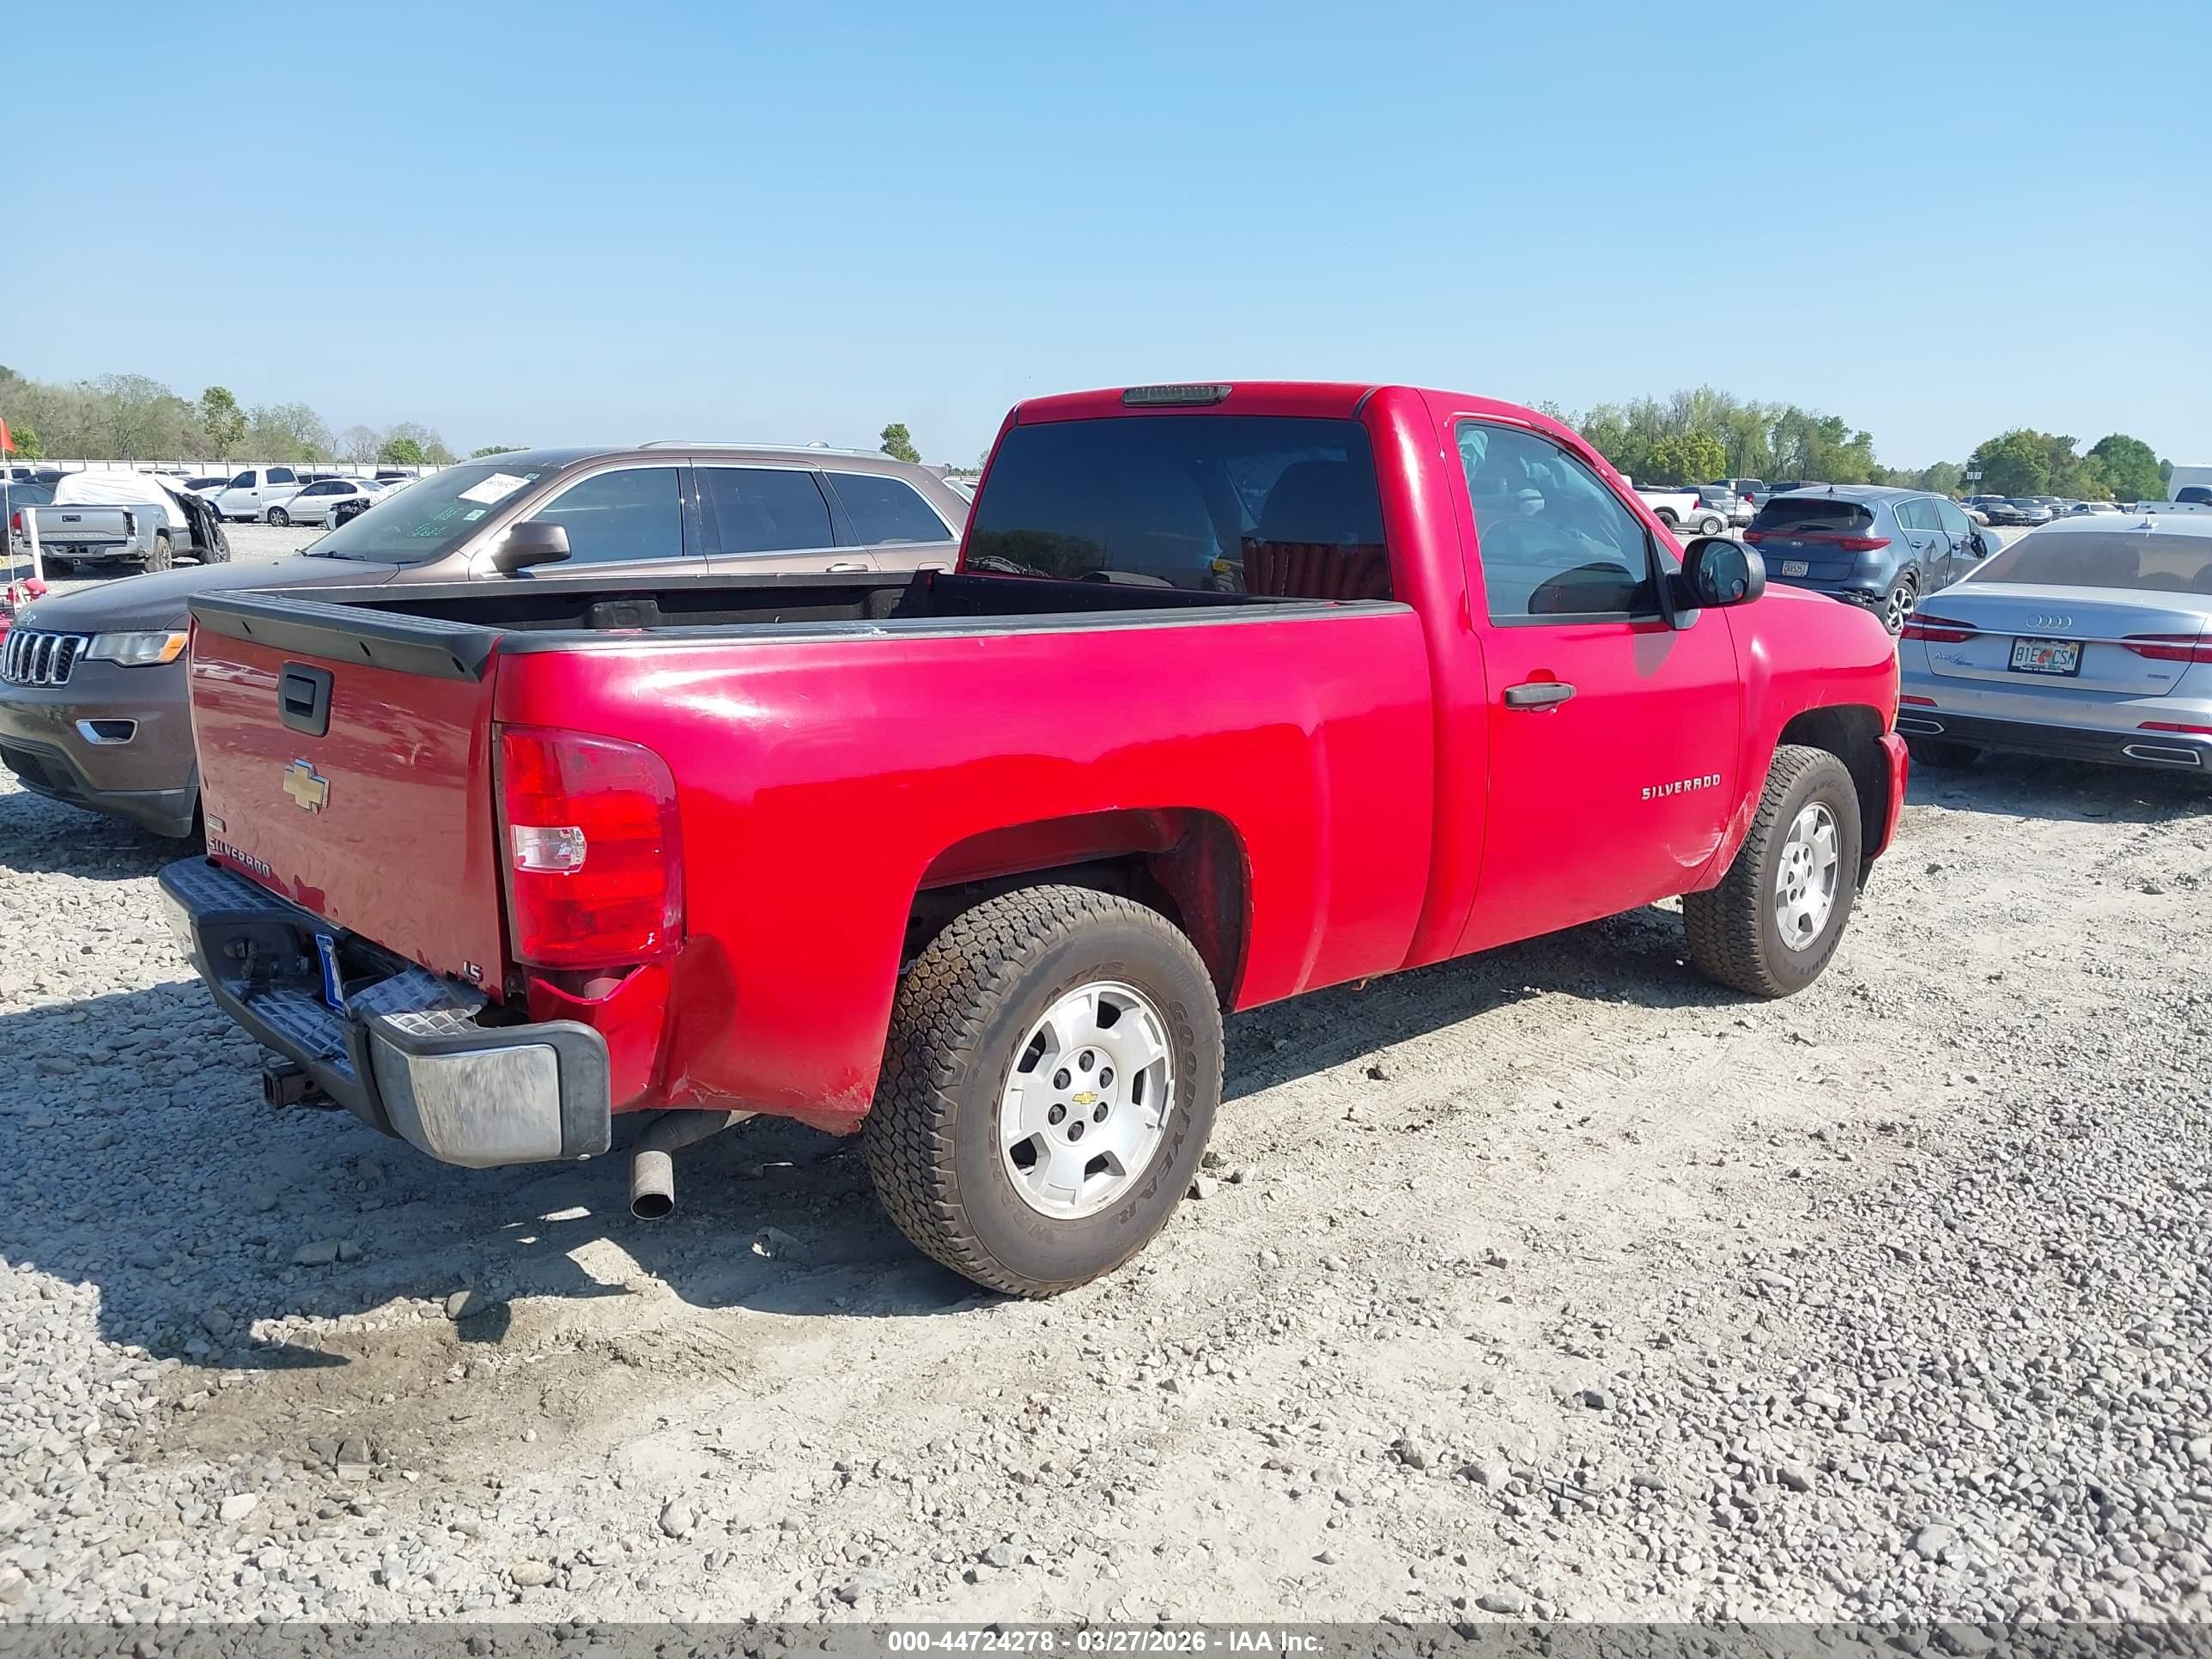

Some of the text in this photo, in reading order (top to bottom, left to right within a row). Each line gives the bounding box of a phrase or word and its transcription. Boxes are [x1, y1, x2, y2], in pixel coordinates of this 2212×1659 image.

[1641, 774, 1721, 801] SILVERADO
[209, 836, 270, 878] SILVERADO
[463, 960, 483, 985] LS
[1118, 999, 1198, 1224] GOODYEAR
